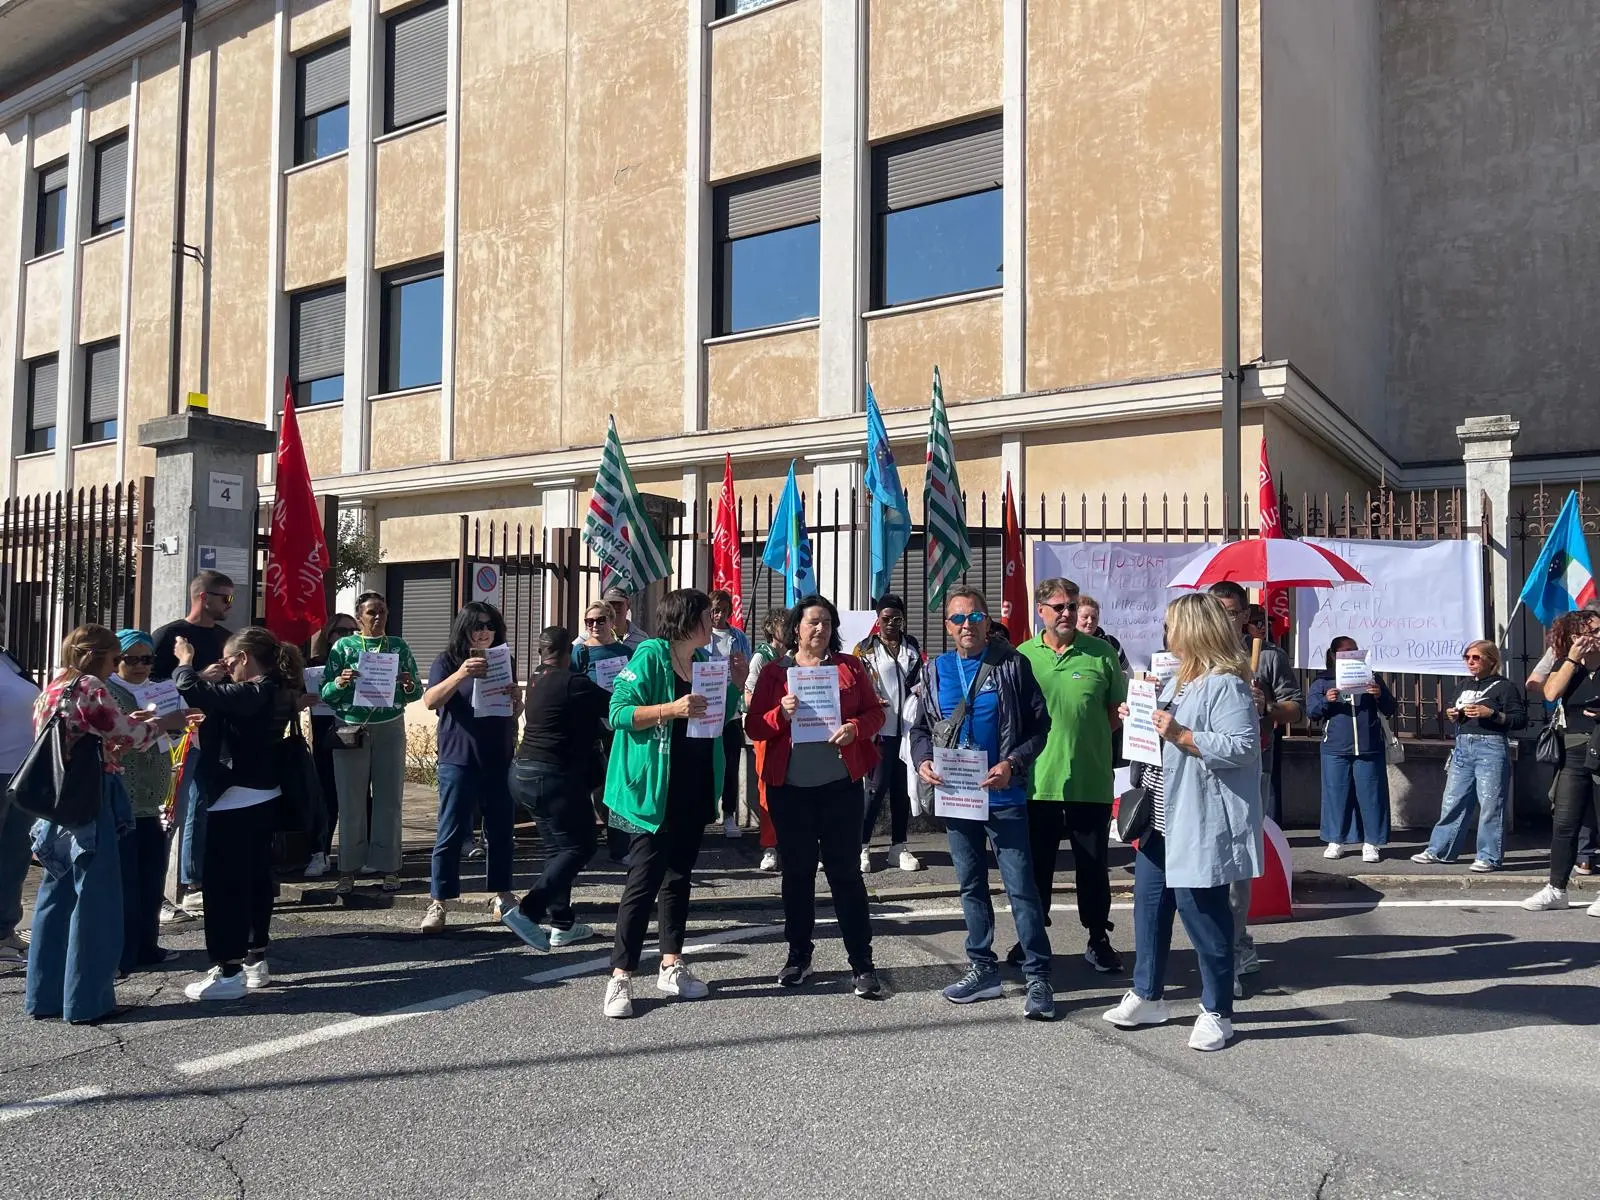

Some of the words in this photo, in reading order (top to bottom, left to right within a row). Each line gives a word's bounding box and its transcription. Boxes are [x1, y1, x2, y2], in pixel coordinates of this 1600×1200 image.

[221, 487, 231, 502] 4
[586, 536, 633, 582] PUBBLIC
[1073, 549, 1164, 571] CHIUSURA
[1319, 598, 1333, 612] A
[1407, 639, 1468, 659] PORTAFO
